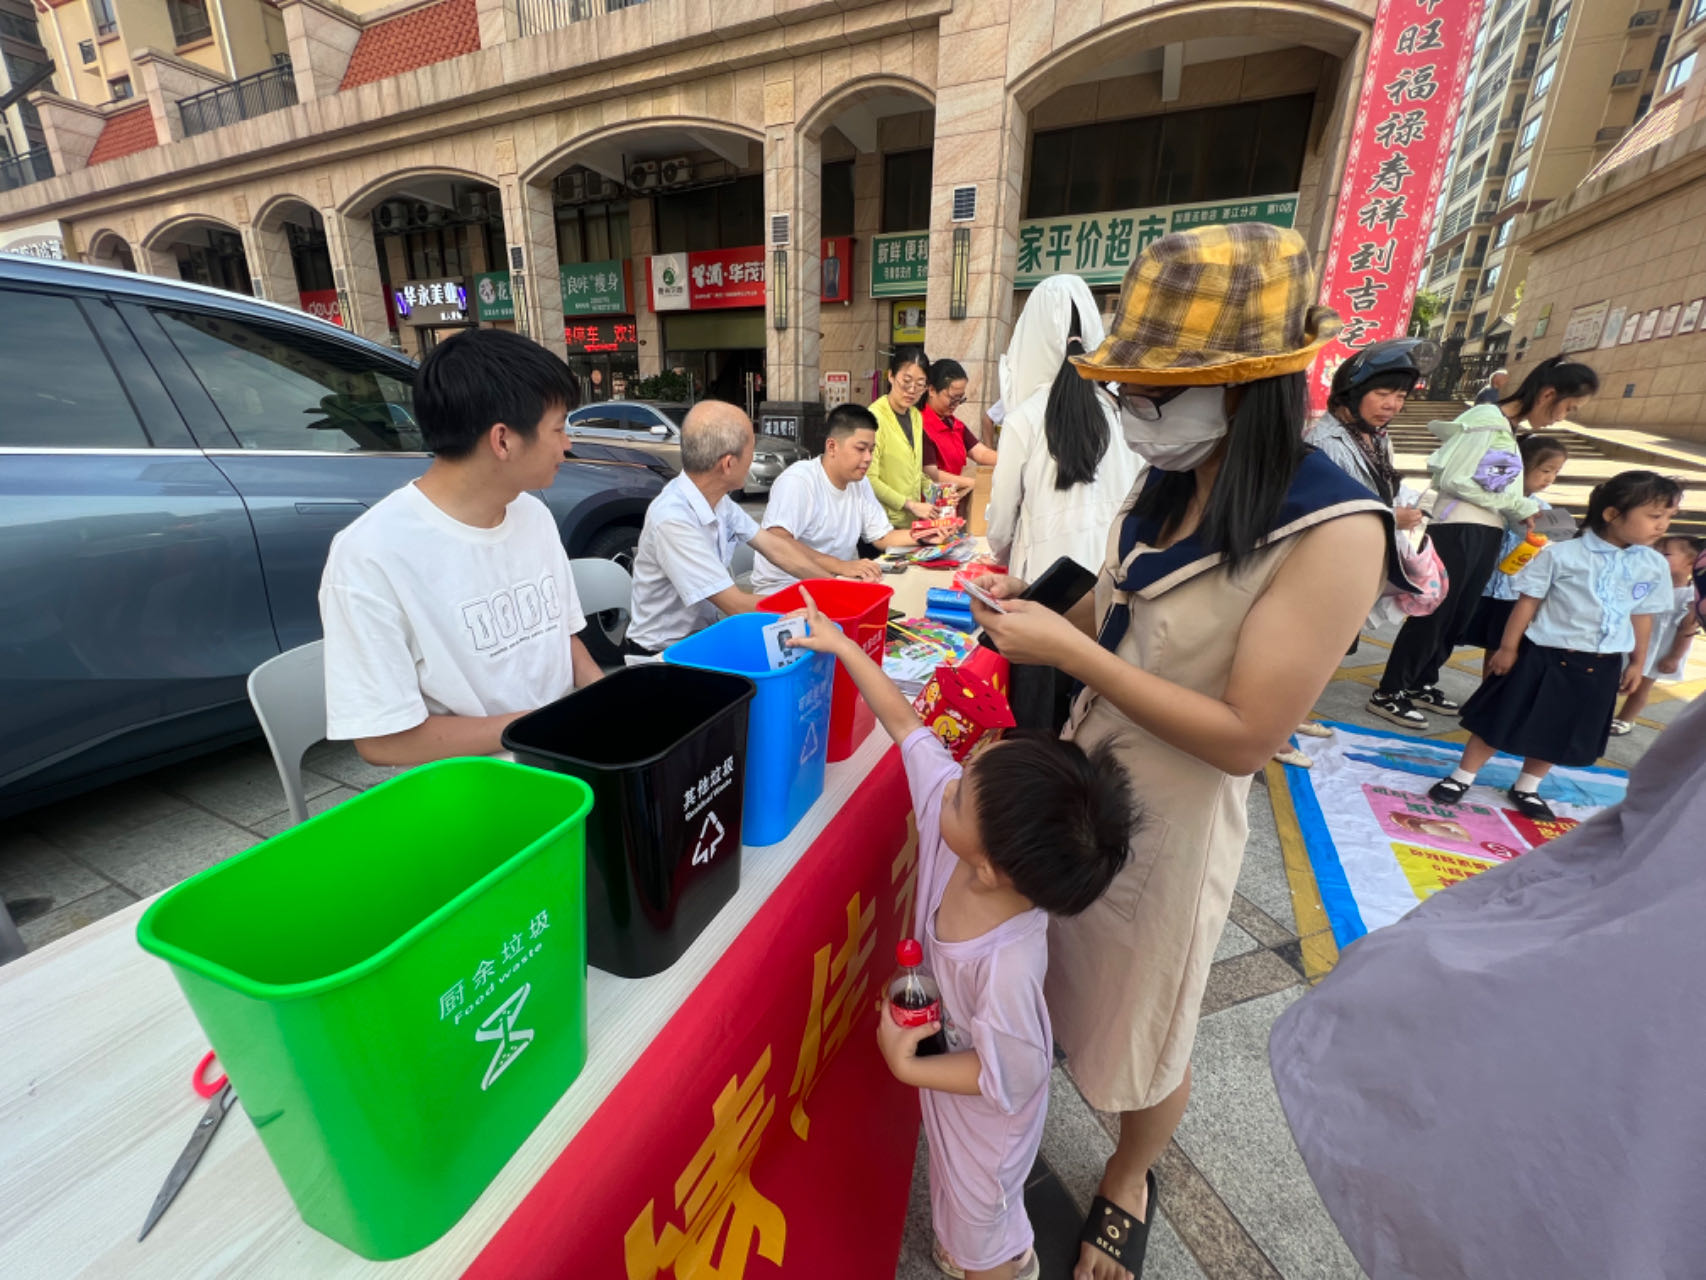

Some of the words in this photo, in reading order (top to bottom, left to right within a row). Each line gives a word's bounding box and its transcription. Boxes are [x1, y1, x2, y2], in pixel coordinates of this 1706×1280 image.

[683, 754, 734, 812] 其他垃圾
[440, 908, 550, 1021] 厨余垃圾
[454, 982, 495, 1025] Food
[499, 942, 542, 984] waste
